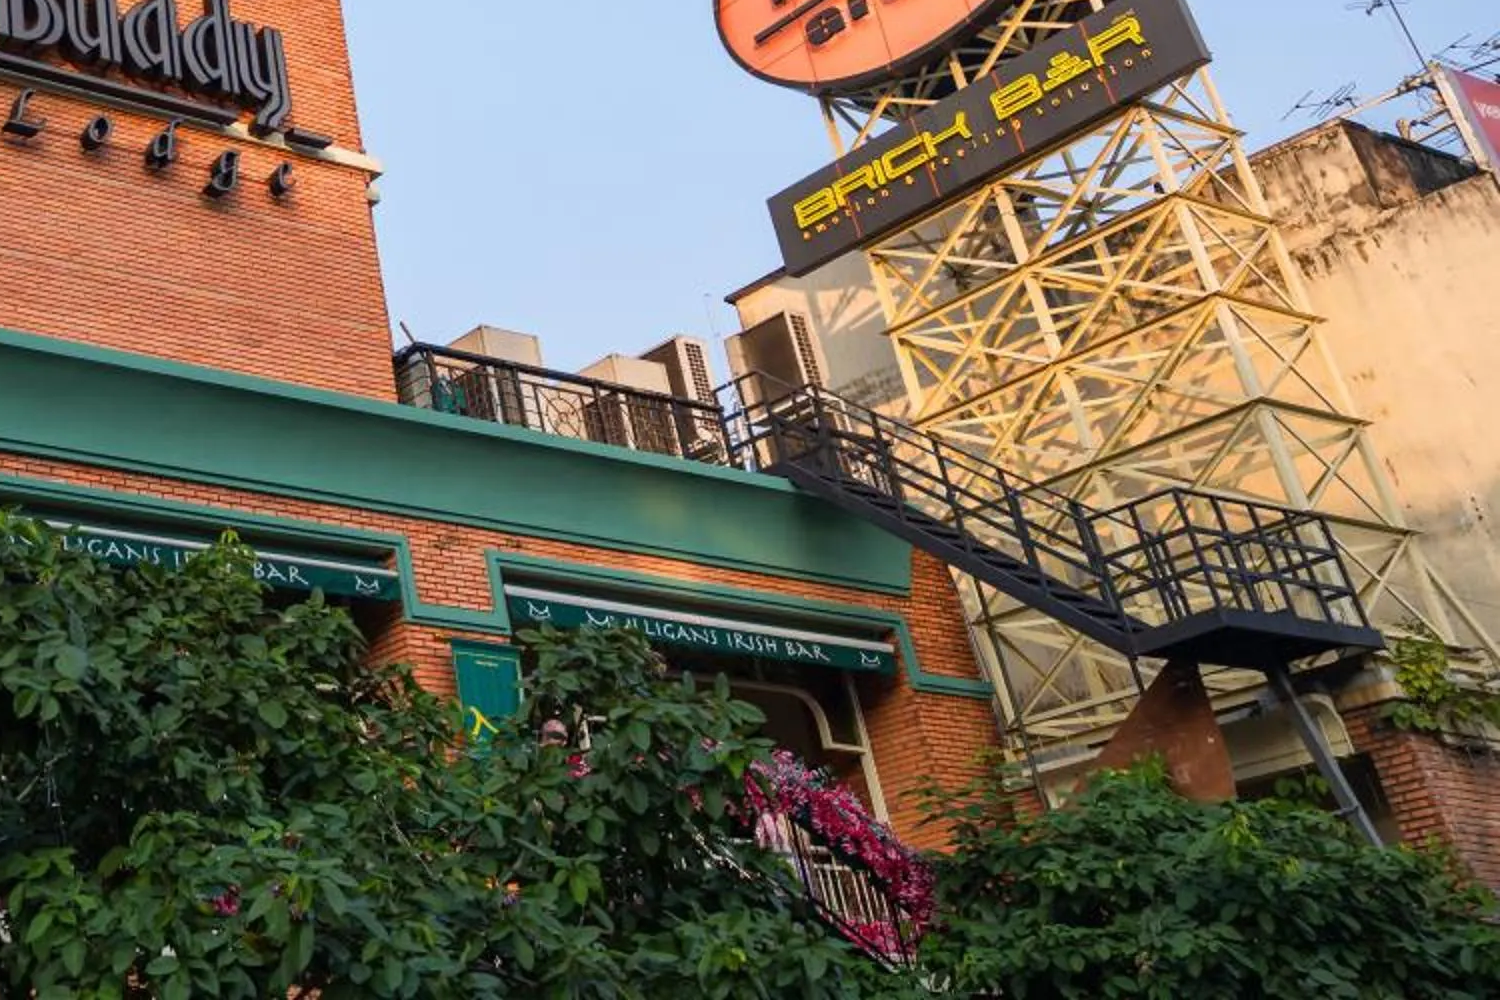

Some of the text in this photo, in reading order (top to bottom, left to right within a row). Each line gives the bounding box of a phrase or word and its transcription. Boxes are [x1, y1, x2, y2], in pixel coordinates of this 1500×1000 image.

[793, 111, 972, 229] BRICK
[252, 562, 309, 585] BAR
[726, 632, 777, 653] IRISH
[785, 641, 830, 663] BAR
